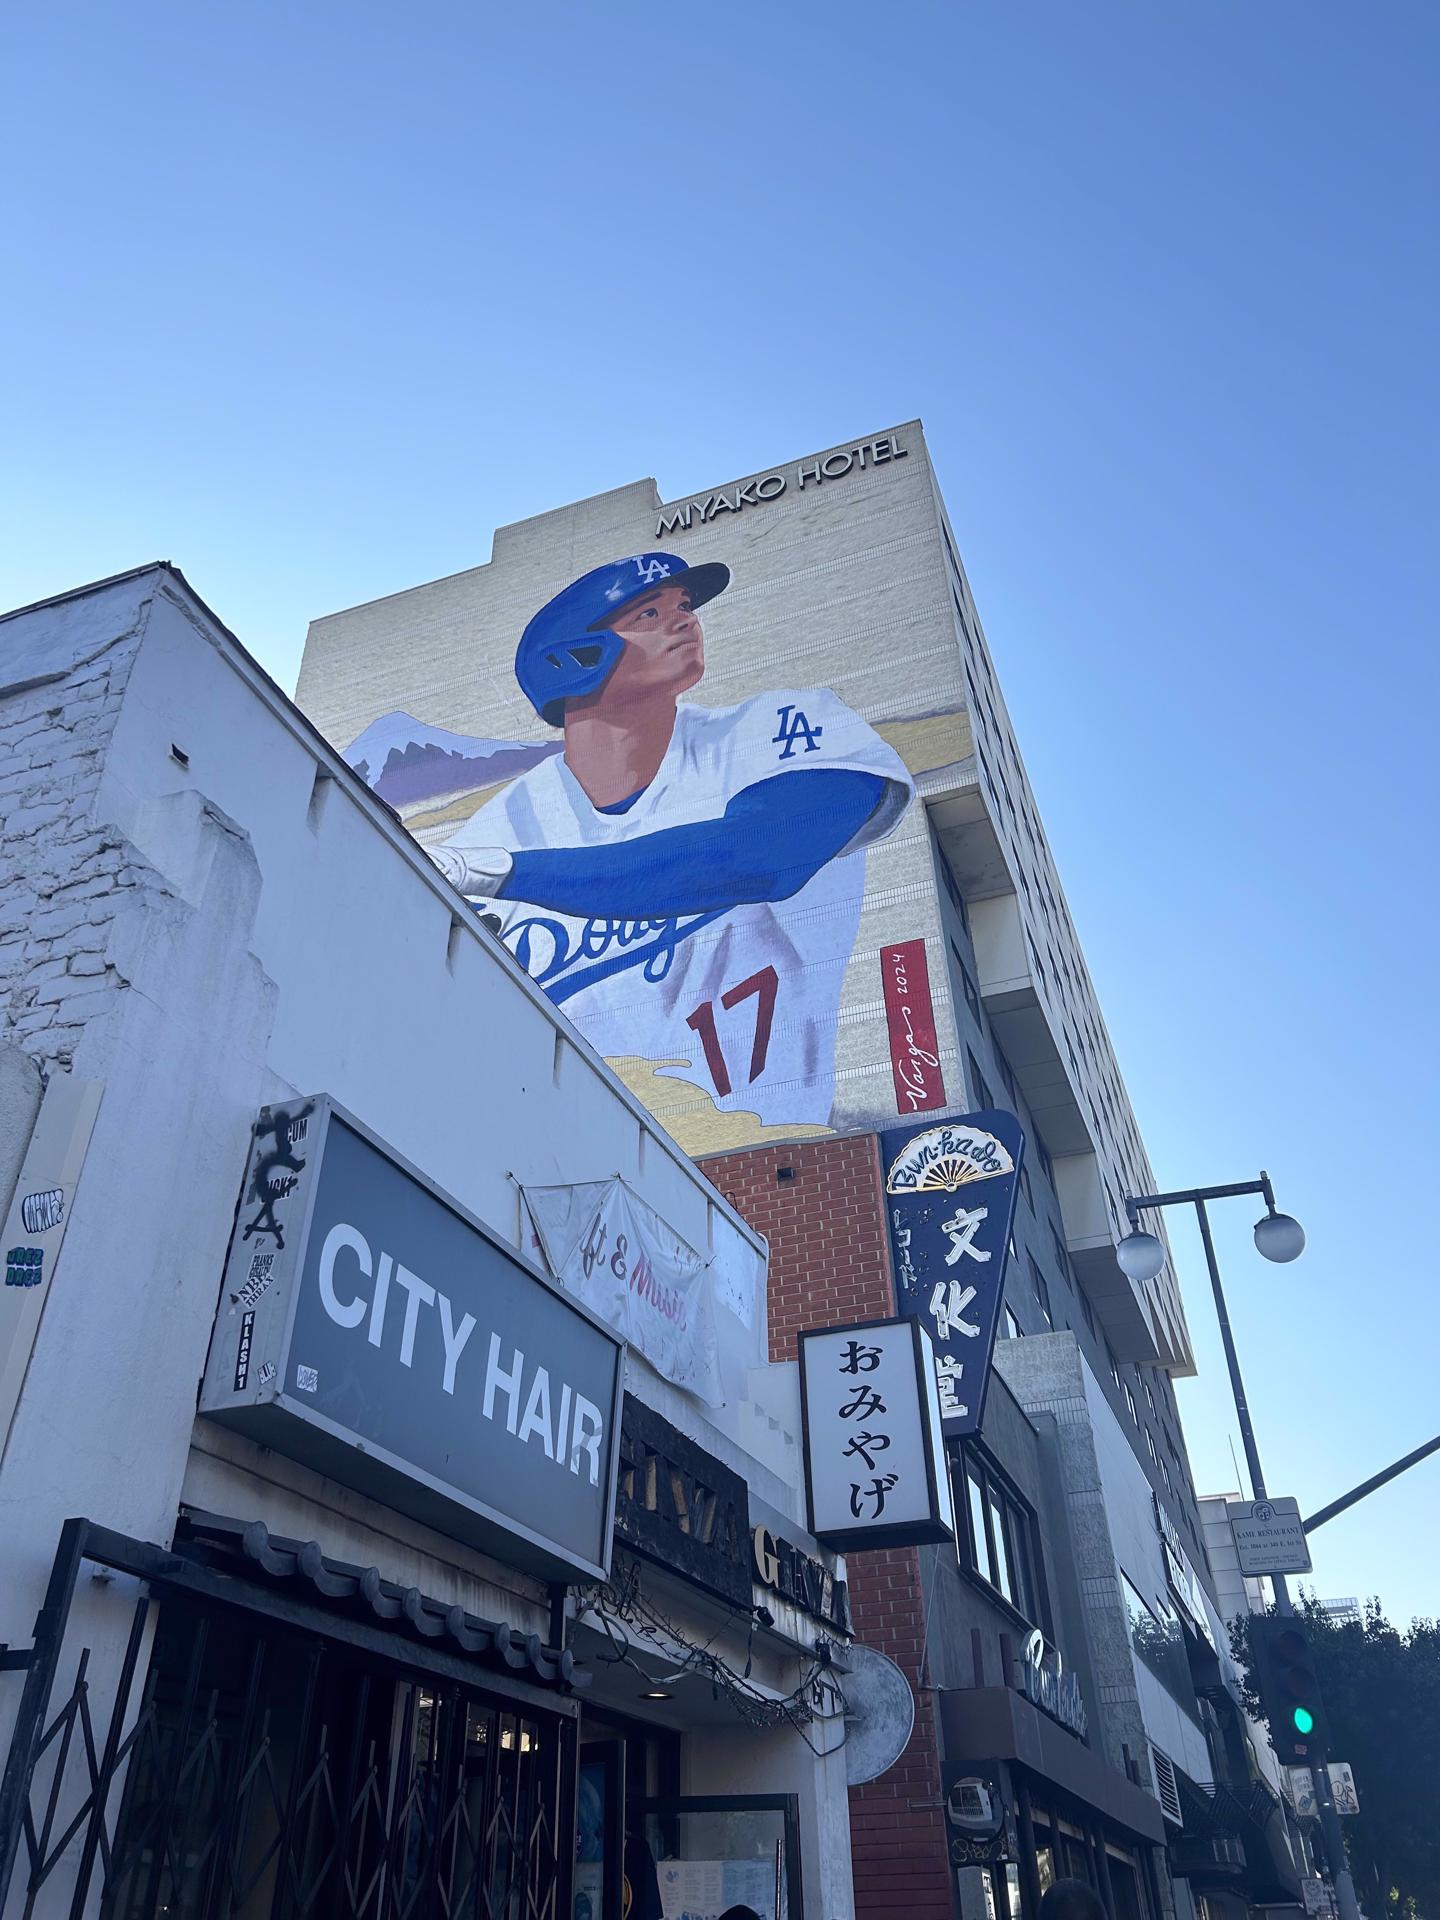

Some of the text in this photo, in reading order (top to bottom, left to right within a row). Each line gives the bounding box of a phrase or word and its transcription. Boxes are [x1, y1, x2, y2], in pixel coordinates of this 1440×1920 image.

[655, 434, 908, 538] MIYAKO HOTEL
[633, 555, 671, 584] LA
[772, 704, 823, 760] LA
[892, 953, 908, 995] 2024
[686, 965, 779, 1098] 17
[610, 1232, 628, 1281] &
[238, 1313, 253, 1388] KLASH1
[319, 1223, 603, 1488] CITY HAIR
[838, 1341, 899, 1520] おみやげ
[1236, 1526, 1300, 1539] KAME RESTAURANT
